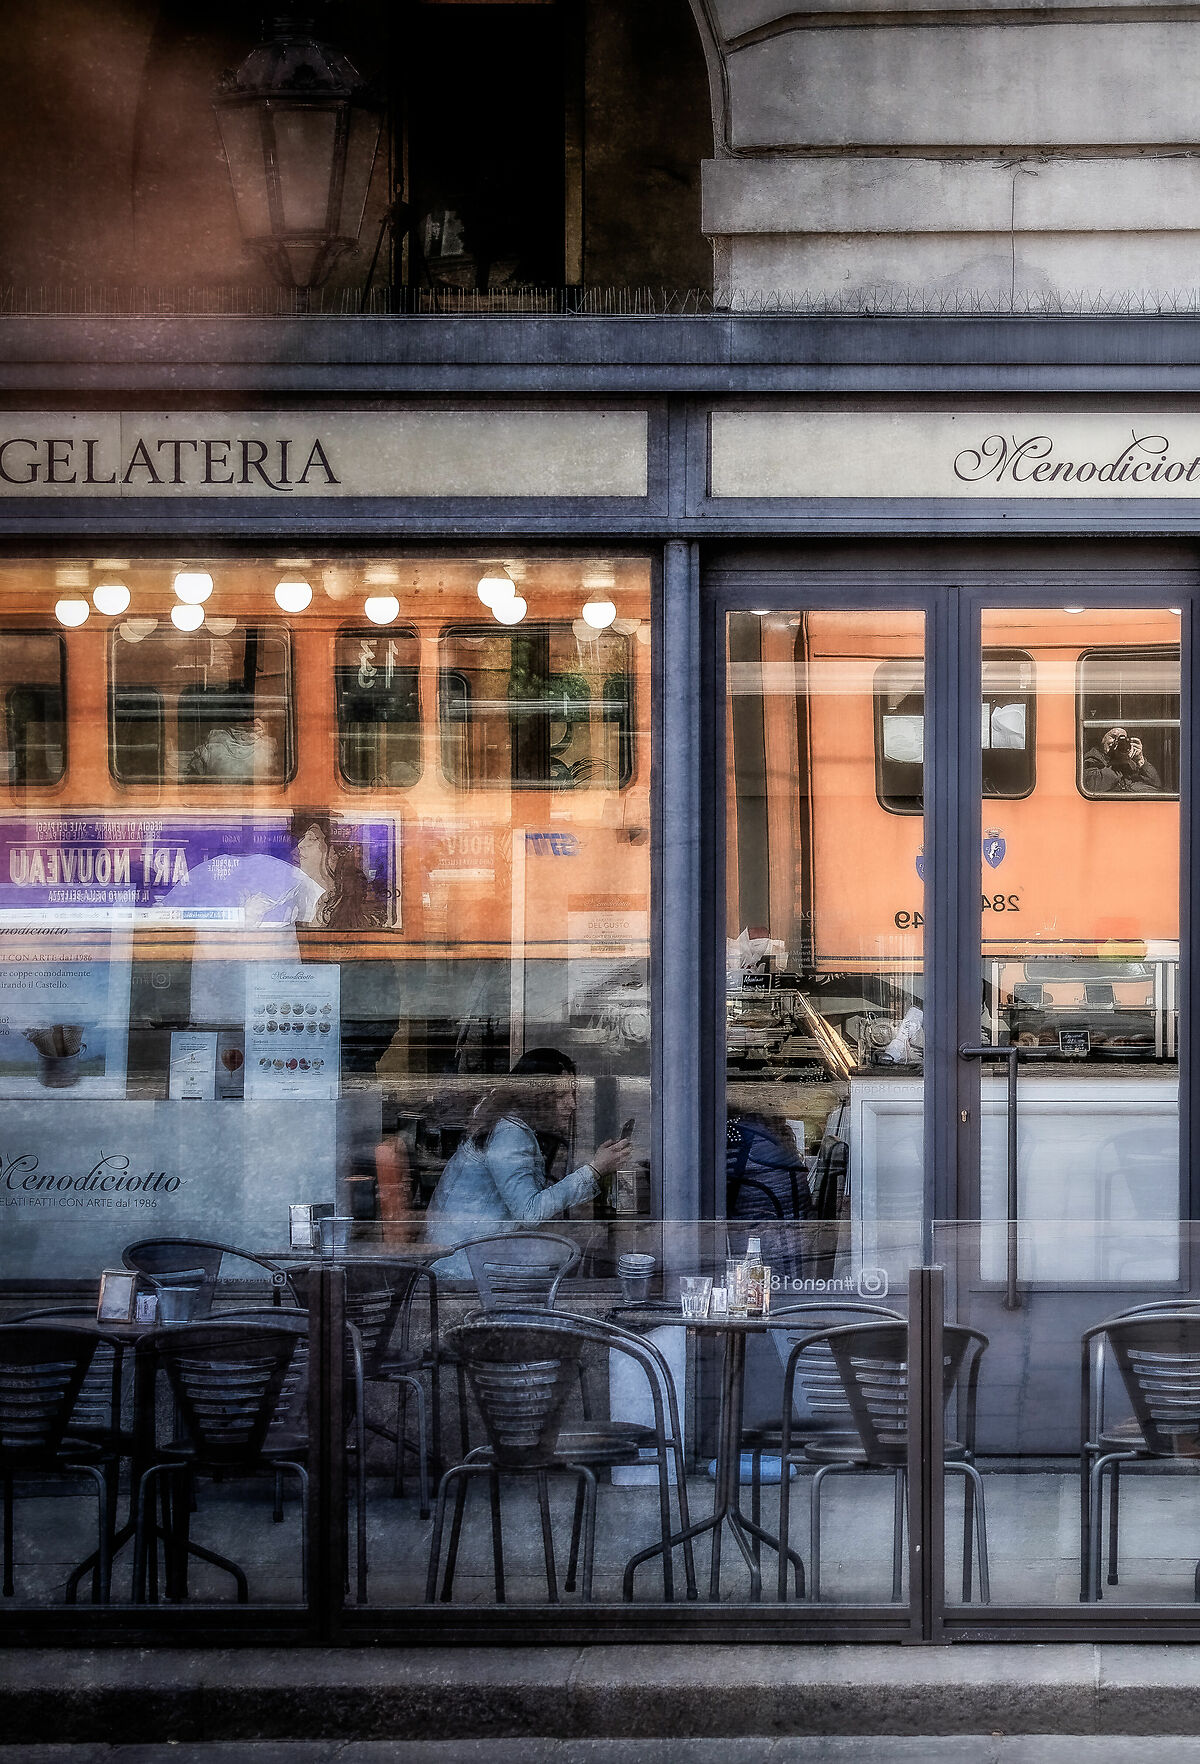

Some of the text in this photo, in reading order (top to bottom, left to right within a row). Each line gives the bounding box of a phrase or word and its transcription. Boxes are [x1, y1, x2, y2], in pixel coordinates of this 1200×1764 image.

[0, 438, 341, 491] GELATERIA
[9, 971, 33, 980] coppe
[34, 969, 91, 978] comodamente
[1, 981, 26, 989] irando
[35, 981, 69, 989] Castello.
[29, 1198, 56, 1207] FATTI
[59, 1198, 84, 1208] CON
[86, 1198, 113, 1208] ARTE
[116, 1198, 130, 1208] dal
[134, 1198, 157, 1208] 1986
